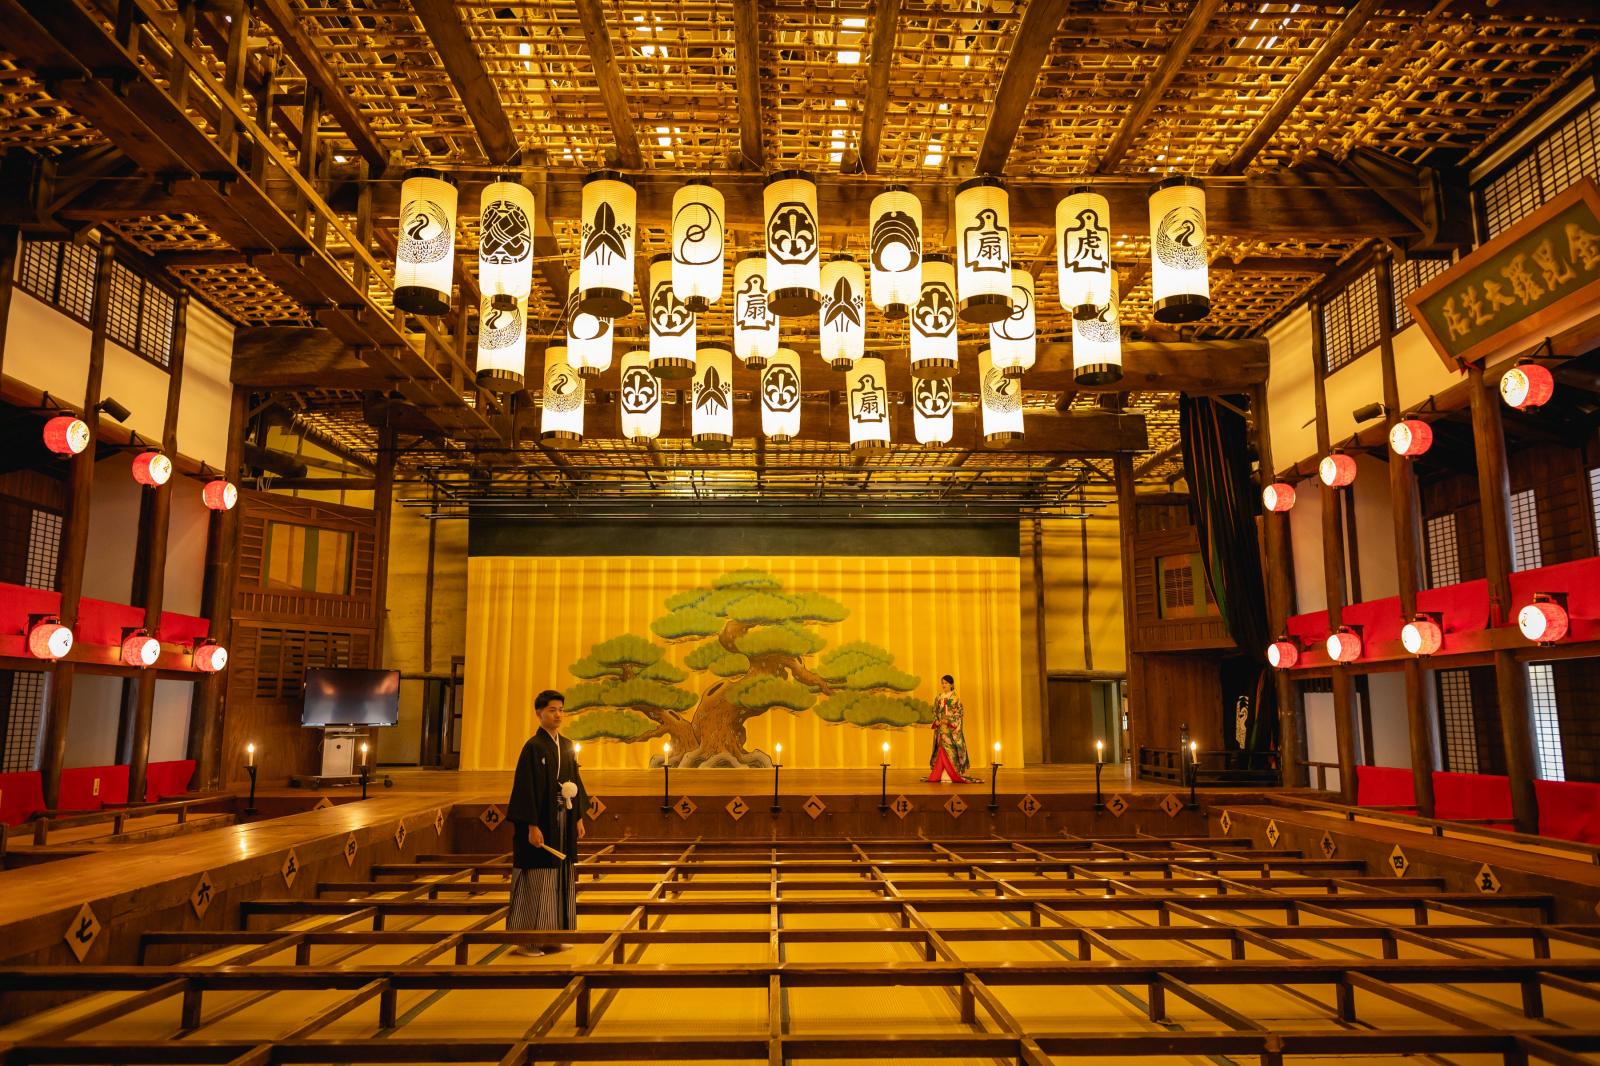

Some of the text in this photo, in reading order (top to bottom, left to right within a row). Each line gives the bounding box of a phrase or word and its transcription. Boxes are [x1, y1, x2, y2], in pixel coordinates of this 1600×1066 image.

[977, 231, 1002, 261] 扇
[1078, 227, 1103, 261] 虎
[743, 294, 767, 321] 扇
[859, 392, 880, 414] 扇
[679, 800, 692, 814] ち
[732, 801, 744, 815] と
[807, 801, 822, 811] へ
[896, 800, 908, 813] ほ
[951, 800, 963, 812] に
[1023, 800, 1036, 812] は
[1111, 799, 1124, 812] ろ
[1166, 800, 1179, 812] い
[485, 810, 501, 824] ぬ
[347, 840, 356, 855] 四
[286, 857, 296, 877] 五
[1393, 855, 1405, 869] 四
[1481, 872, 1494, 889] 五
[198, 882, 211, 906] 六
[75, 917, 94, 943] 七
